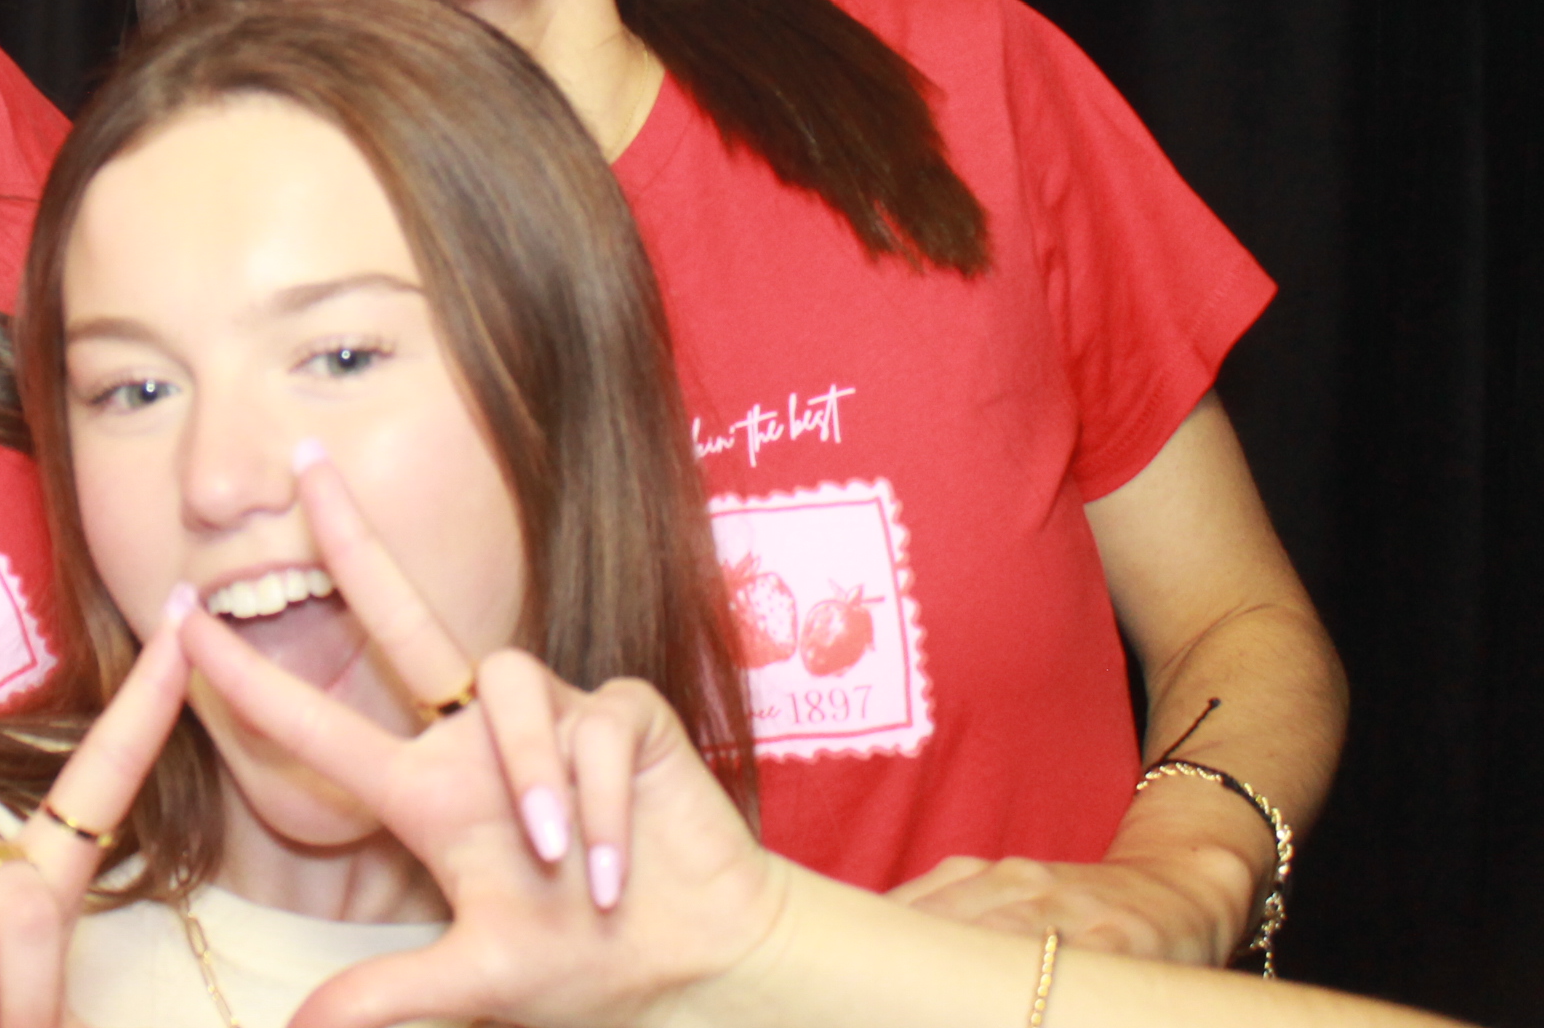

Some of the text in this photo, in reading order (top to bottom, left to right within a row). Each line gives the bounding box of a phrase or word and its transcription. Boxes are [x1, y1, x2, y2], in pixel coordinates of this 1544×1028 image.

[735, 404, 784, 467] the
[788, 383, 856, 443] best
[788, 684, 872, 724] 1897
